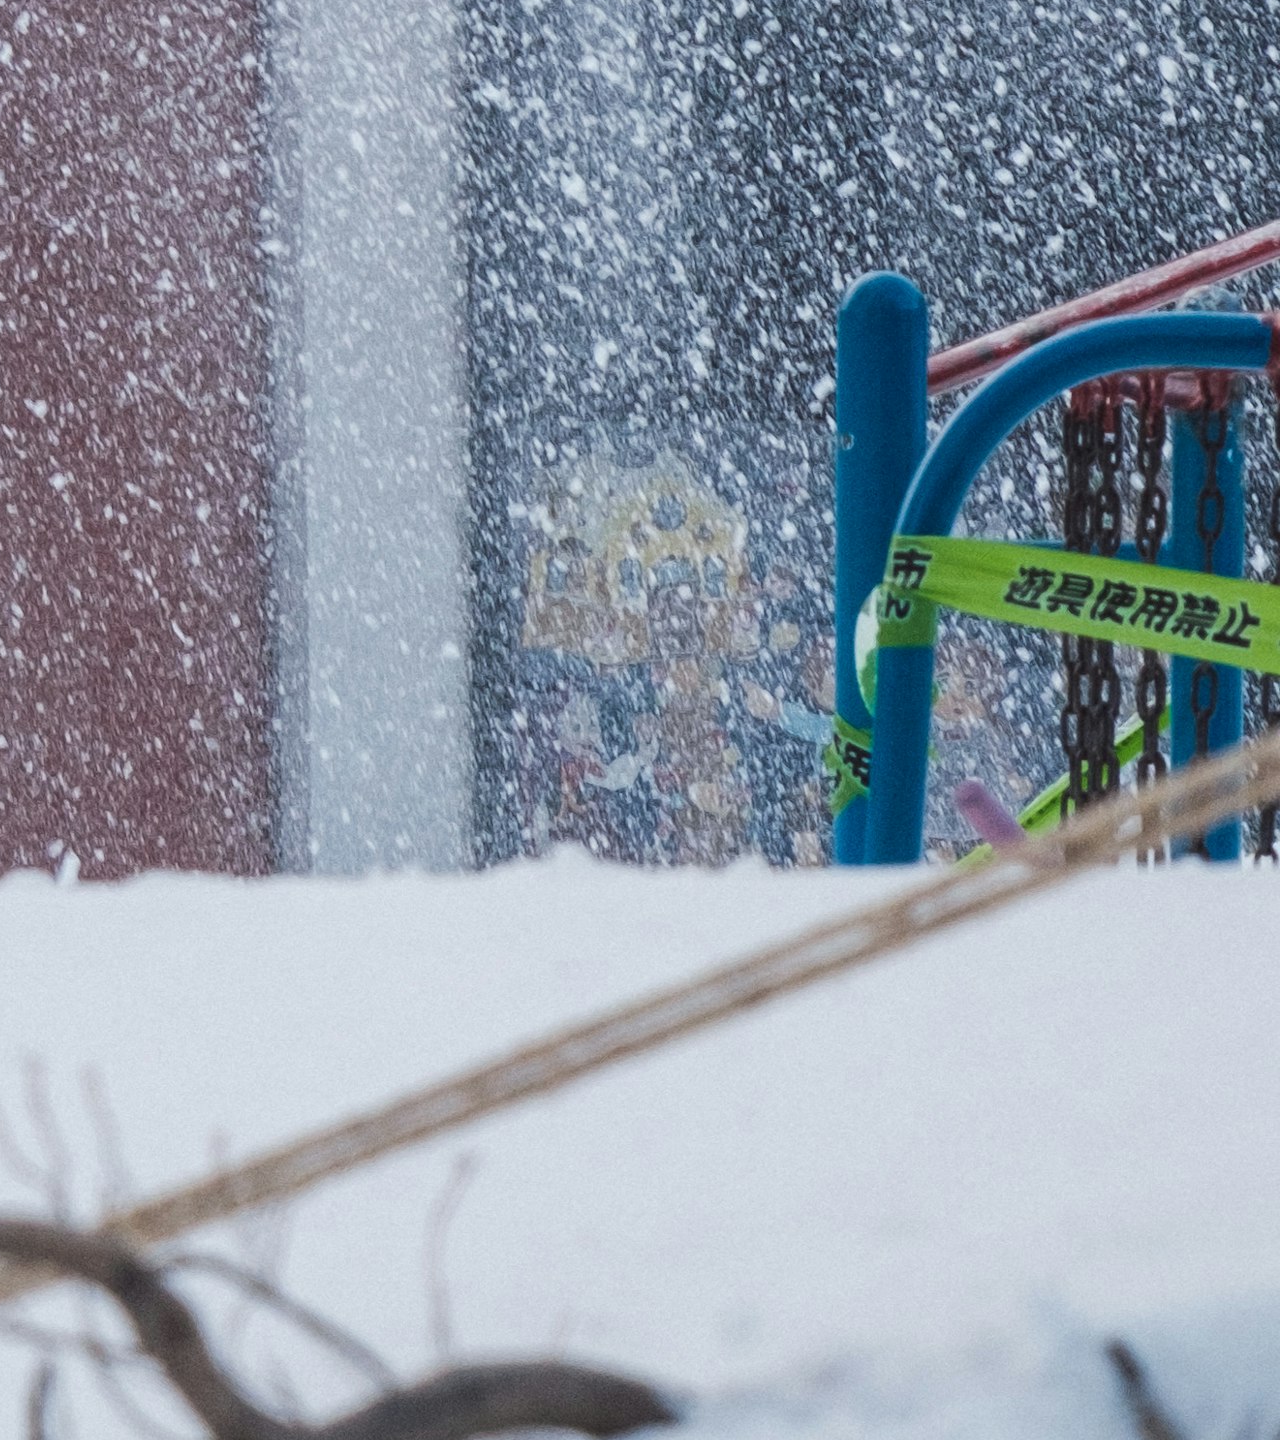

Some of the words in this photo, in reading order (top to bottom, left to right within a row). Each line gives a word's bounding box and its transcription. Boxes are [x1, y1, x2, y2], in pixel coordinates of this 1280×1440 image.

[1003, 565, 1261, 649] 遊具使用禁止
